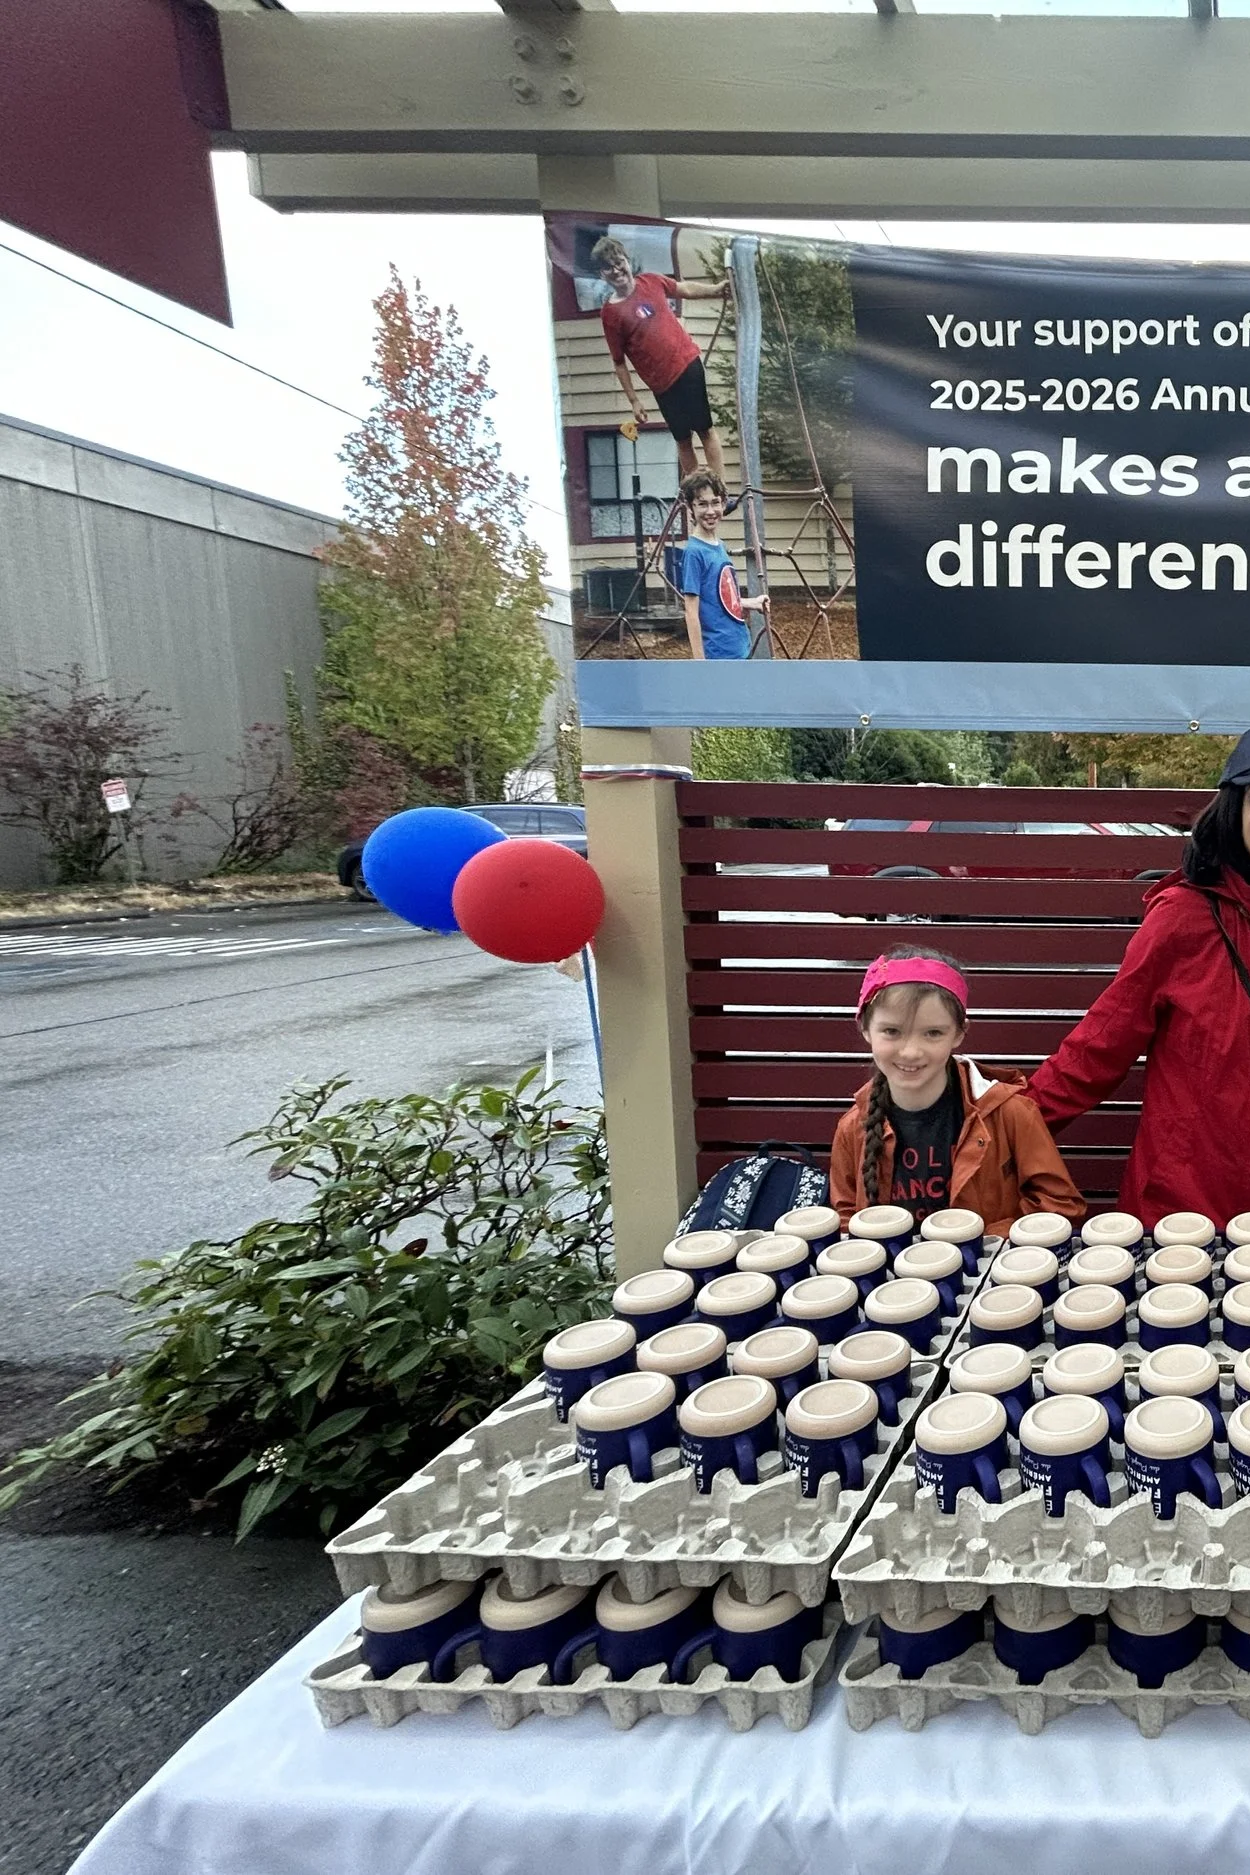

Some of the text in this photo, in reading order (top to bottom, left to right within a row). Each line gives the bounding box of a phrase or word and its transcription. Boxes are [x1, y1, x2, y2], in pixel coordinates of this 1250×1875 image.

[926, 314, 1022, 348] Your
[1034, 314, 1201, 354] support
[929, 377, 1140, 412] 2025-2026
[927, 437, 1200, 497] makes
